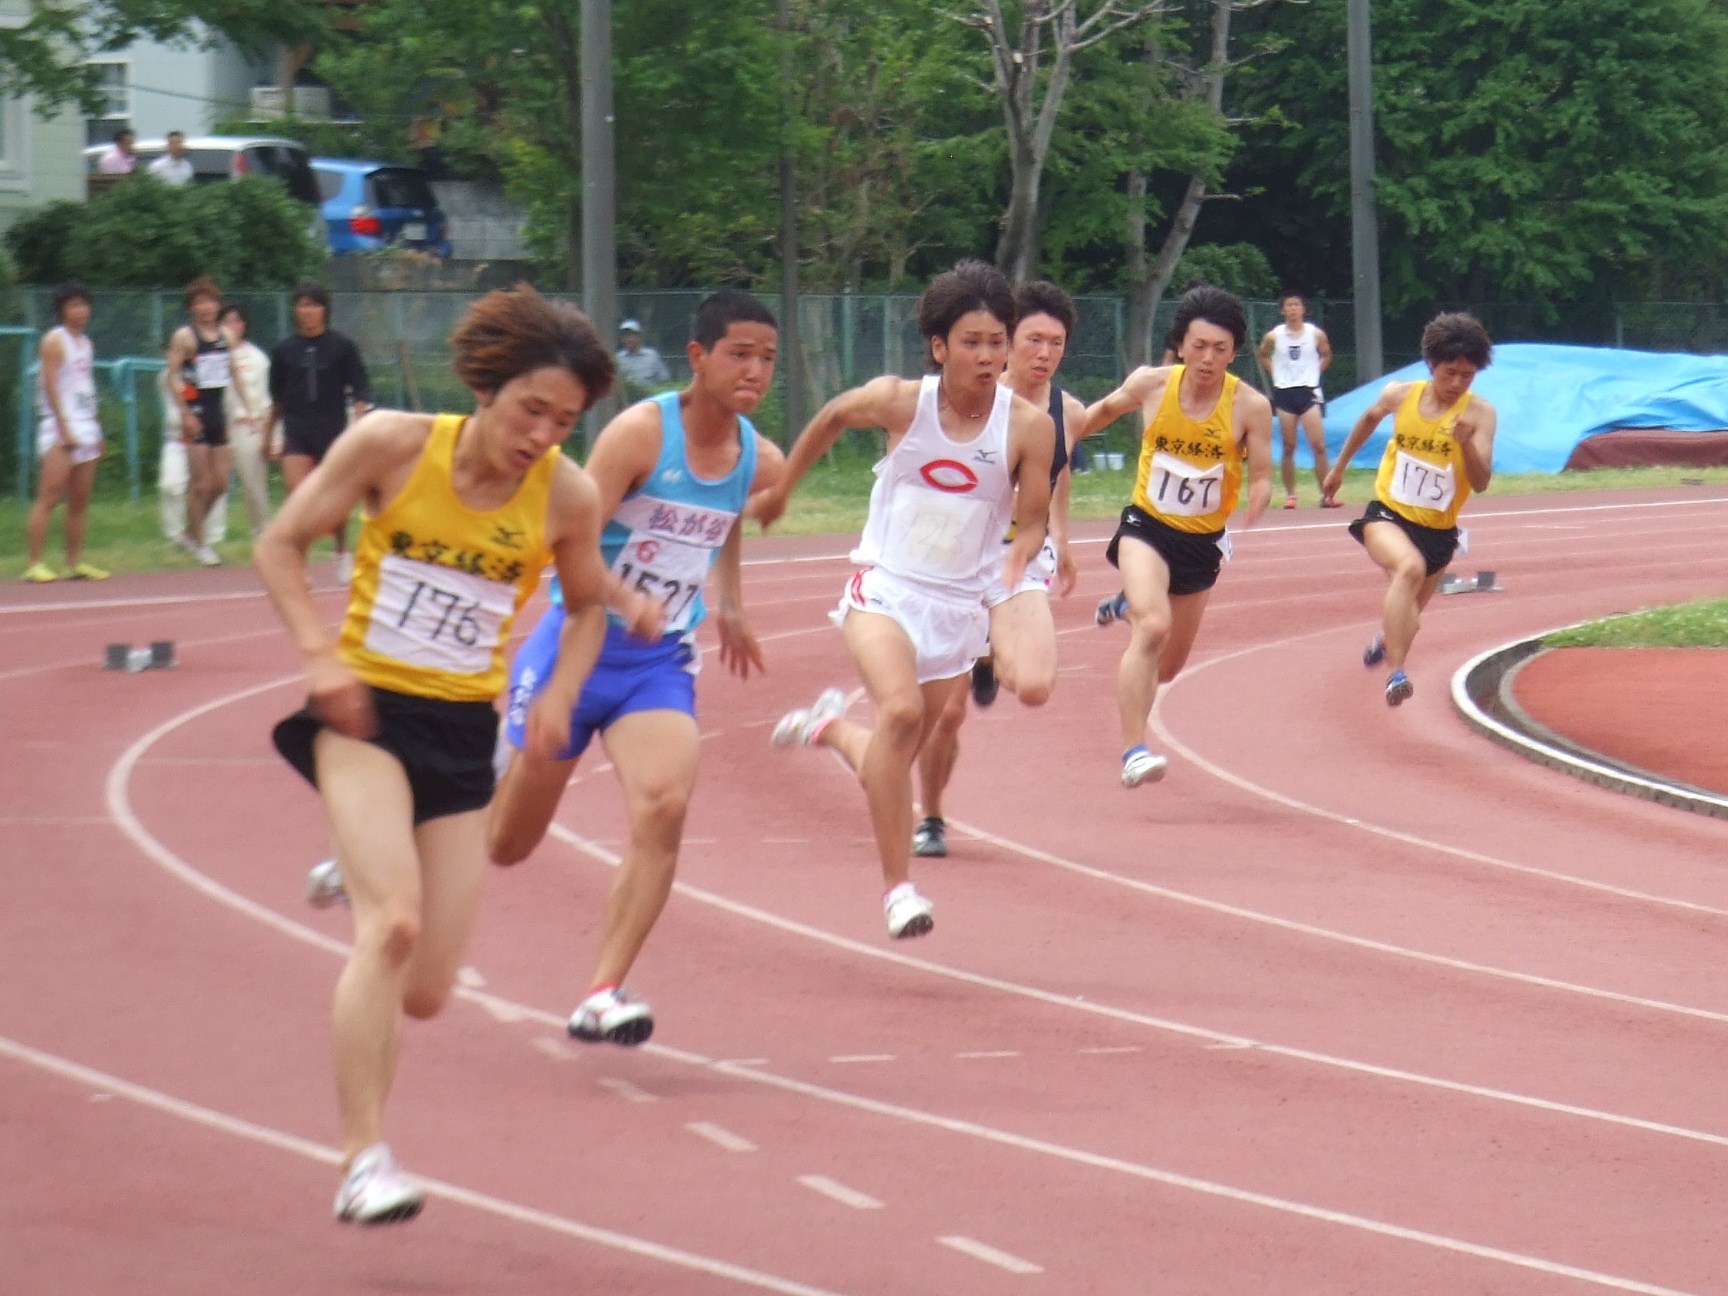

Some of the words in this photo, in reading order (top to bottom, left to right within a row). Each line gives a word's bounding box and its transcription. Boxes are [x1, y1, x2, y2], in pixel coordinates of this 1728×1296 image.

[1158, 470, 1218, 508] 167
[1402, 462, 1446, 501] 175
[397, 582, 480, 646] 176
